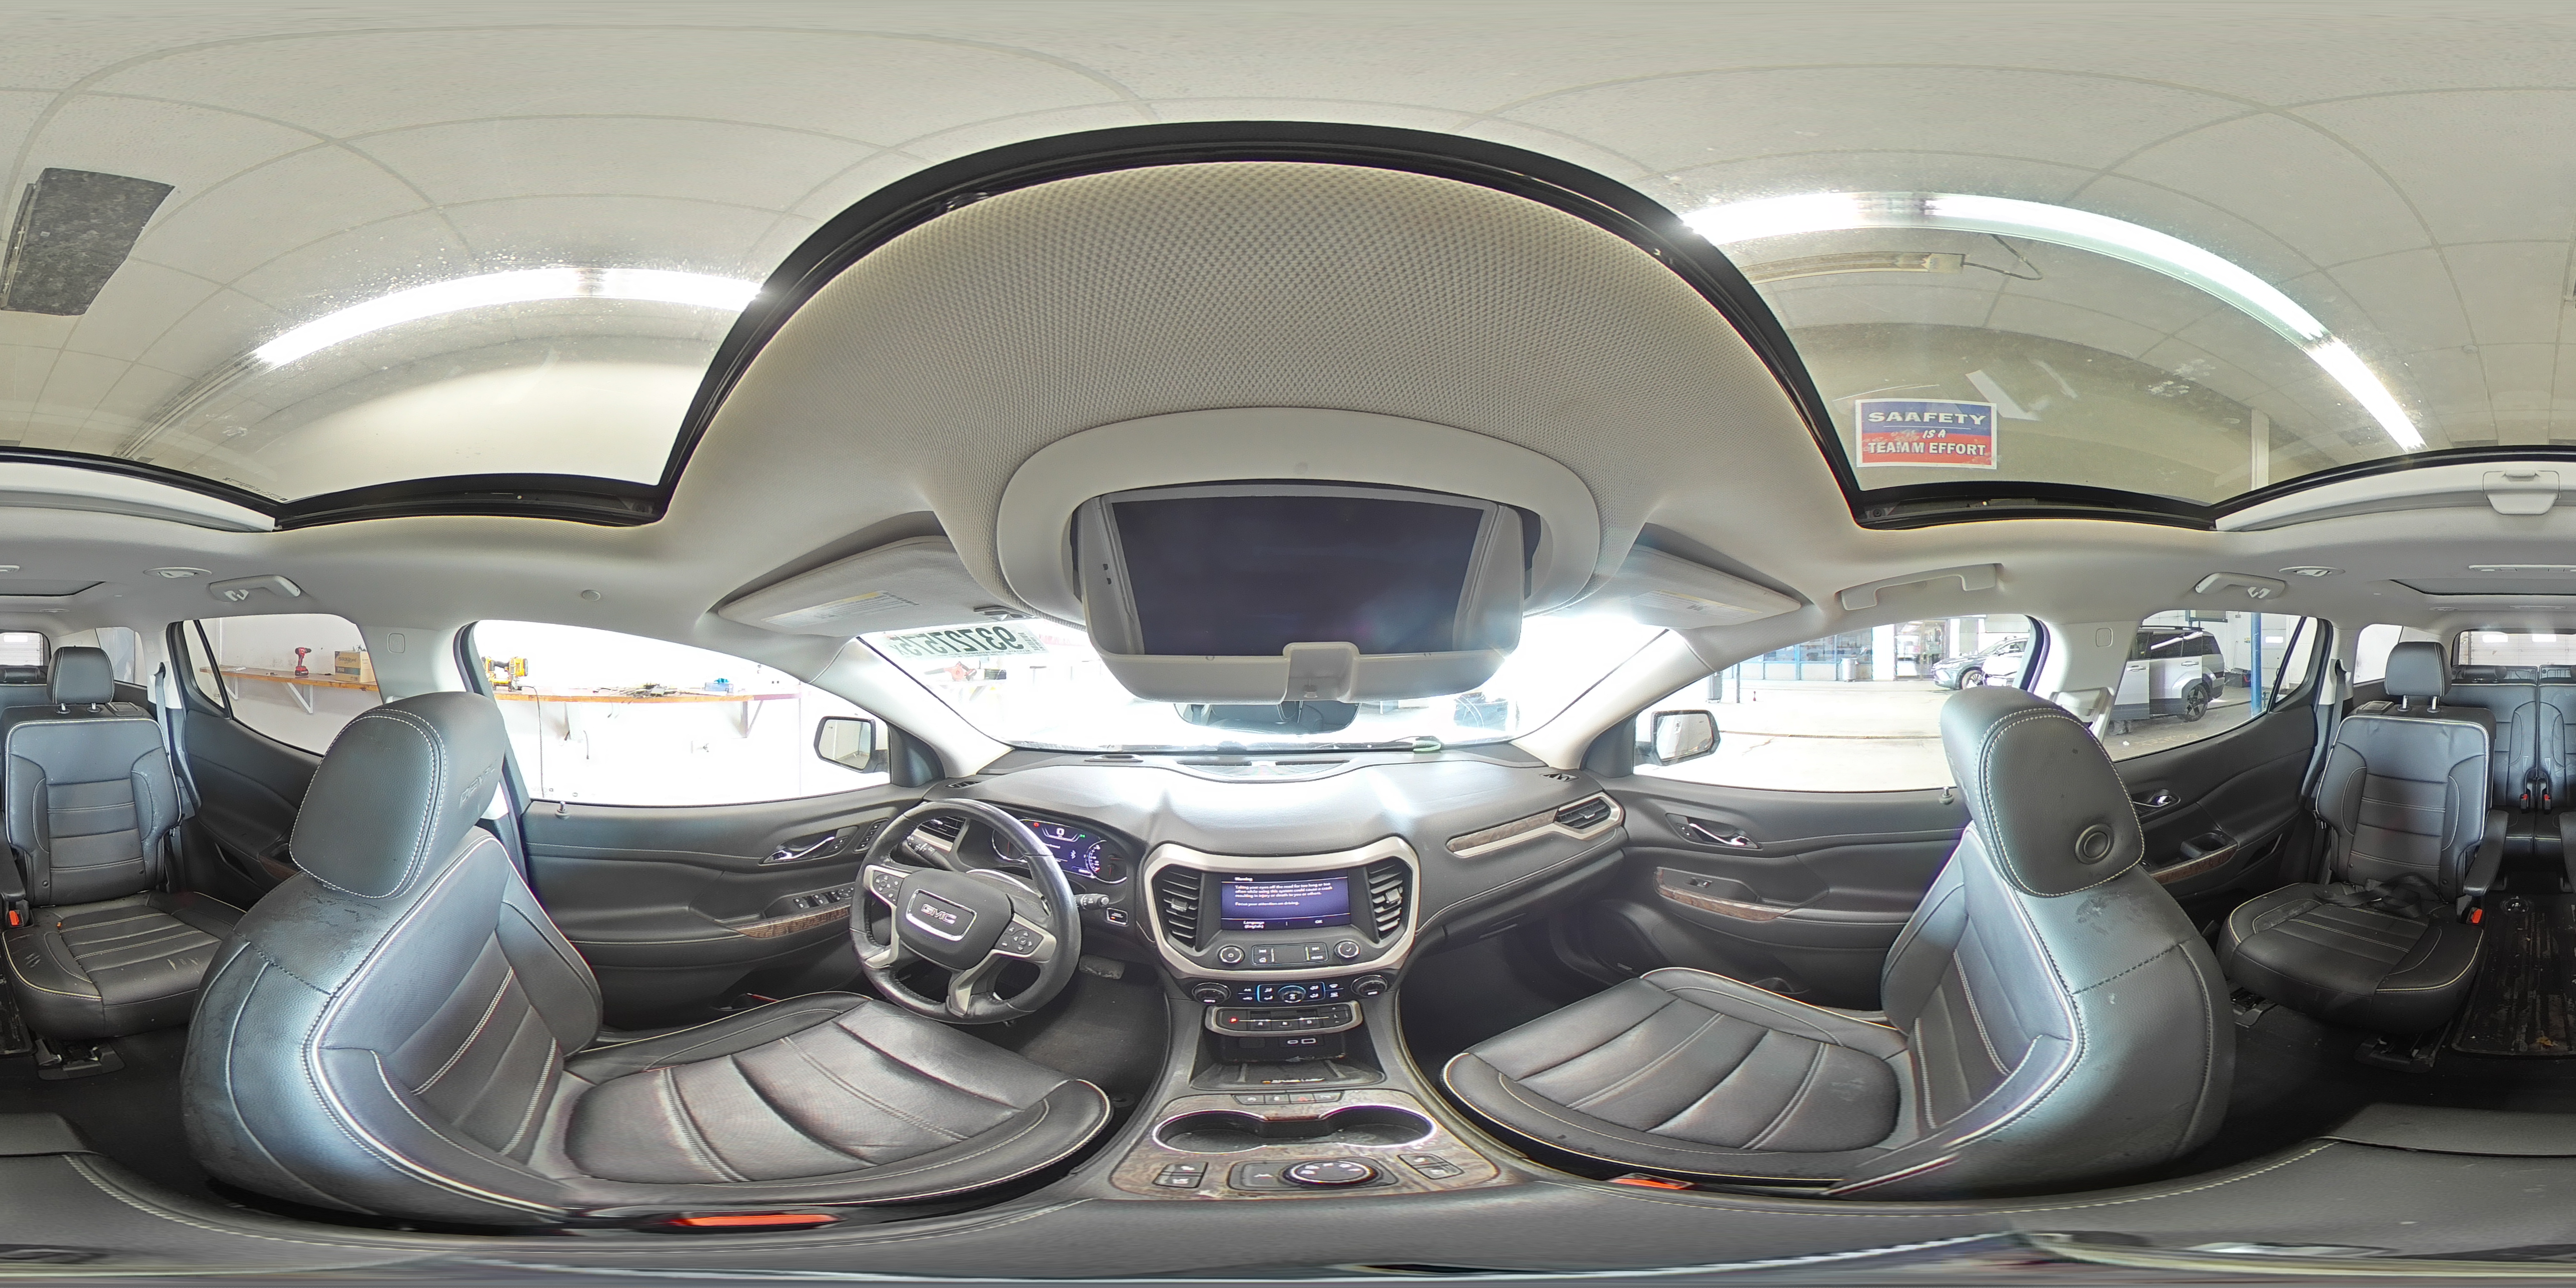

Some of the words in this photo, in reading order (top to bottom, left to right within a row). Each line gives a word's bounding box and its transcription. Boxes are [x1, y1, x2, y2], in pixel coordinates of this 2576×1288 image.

[1868, 412, 1986, 425] SAAFETY
[1922, 429, 1935, 438] IS
[1938, 429, 1946, 438] A
[1929, 443, 1986, 456] EFFORT
[921, 904, 957, 924] GMC
